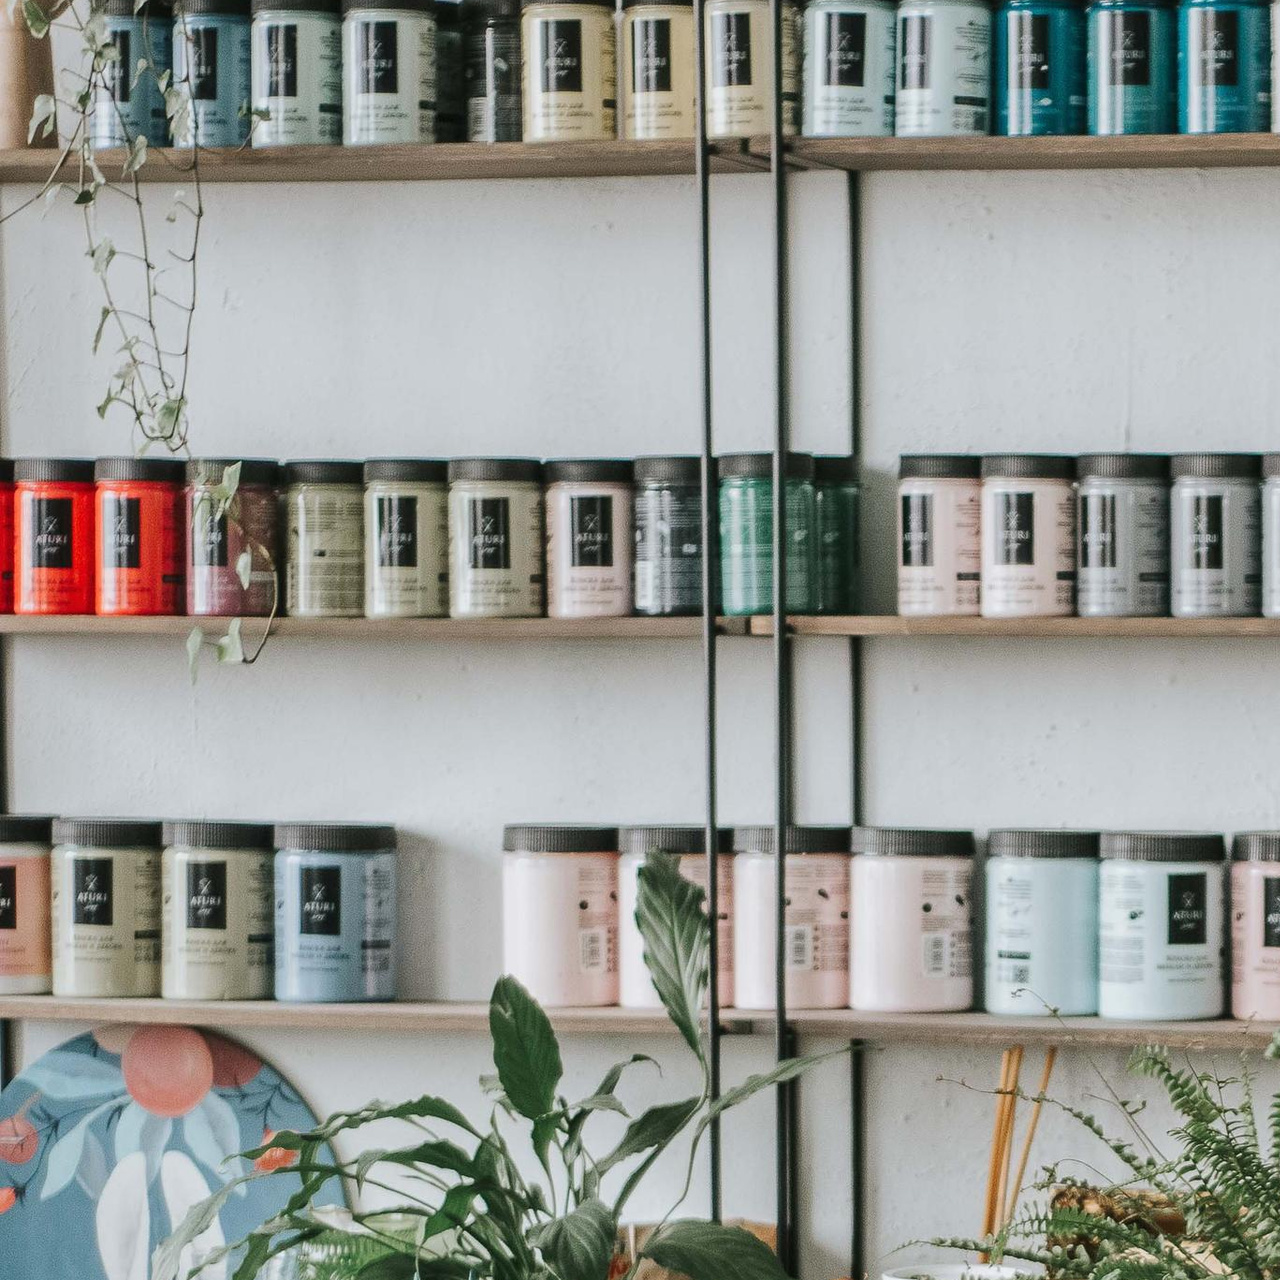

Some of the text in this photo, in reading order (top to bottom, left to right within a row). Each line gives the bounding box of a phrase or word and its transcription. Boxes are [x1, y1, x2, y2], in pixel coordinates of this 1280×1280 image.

[36, 534, 67, 544] ATURI
[472, 534, 505, 545] ATURI
[576, 532, 608, 542] ATURI
[77, 892, 107, 906] ATURI
[190, 895, 222, 908] ATURI
[303, 901, 335, 914] ATURI
[1173, 909, 1203, 920] ATURI
